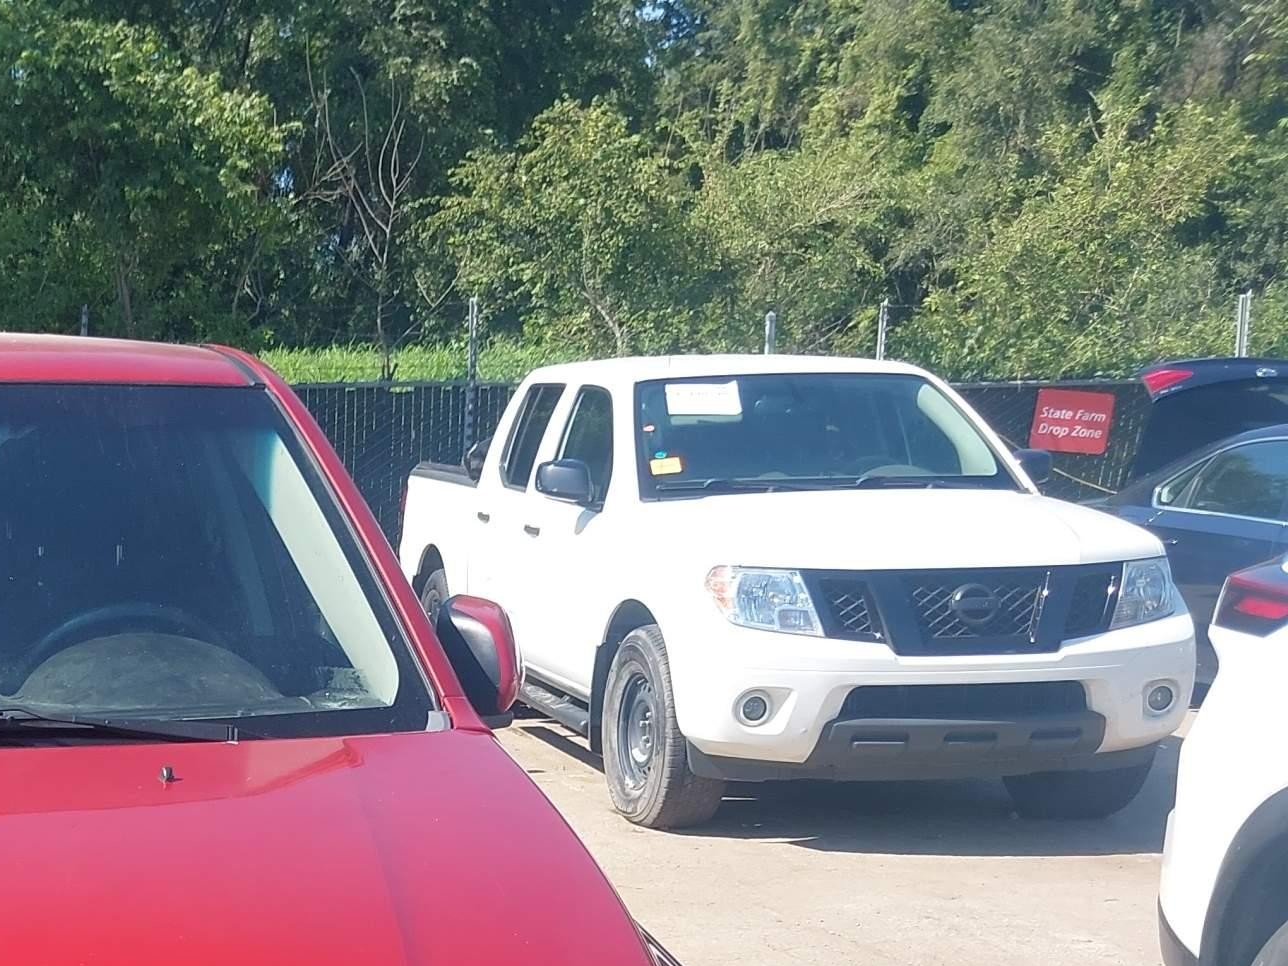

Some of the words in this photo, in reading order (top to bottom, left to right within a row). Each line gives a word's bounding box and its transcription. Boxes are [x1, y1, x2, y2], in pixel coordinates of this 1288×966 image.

[1040, 406, 1073, 420] State
[1074, 409, 1106, 422] Farm
[1037, 423, 1069, 438] Drop
[1070, 425, 1102, 438] Zone
